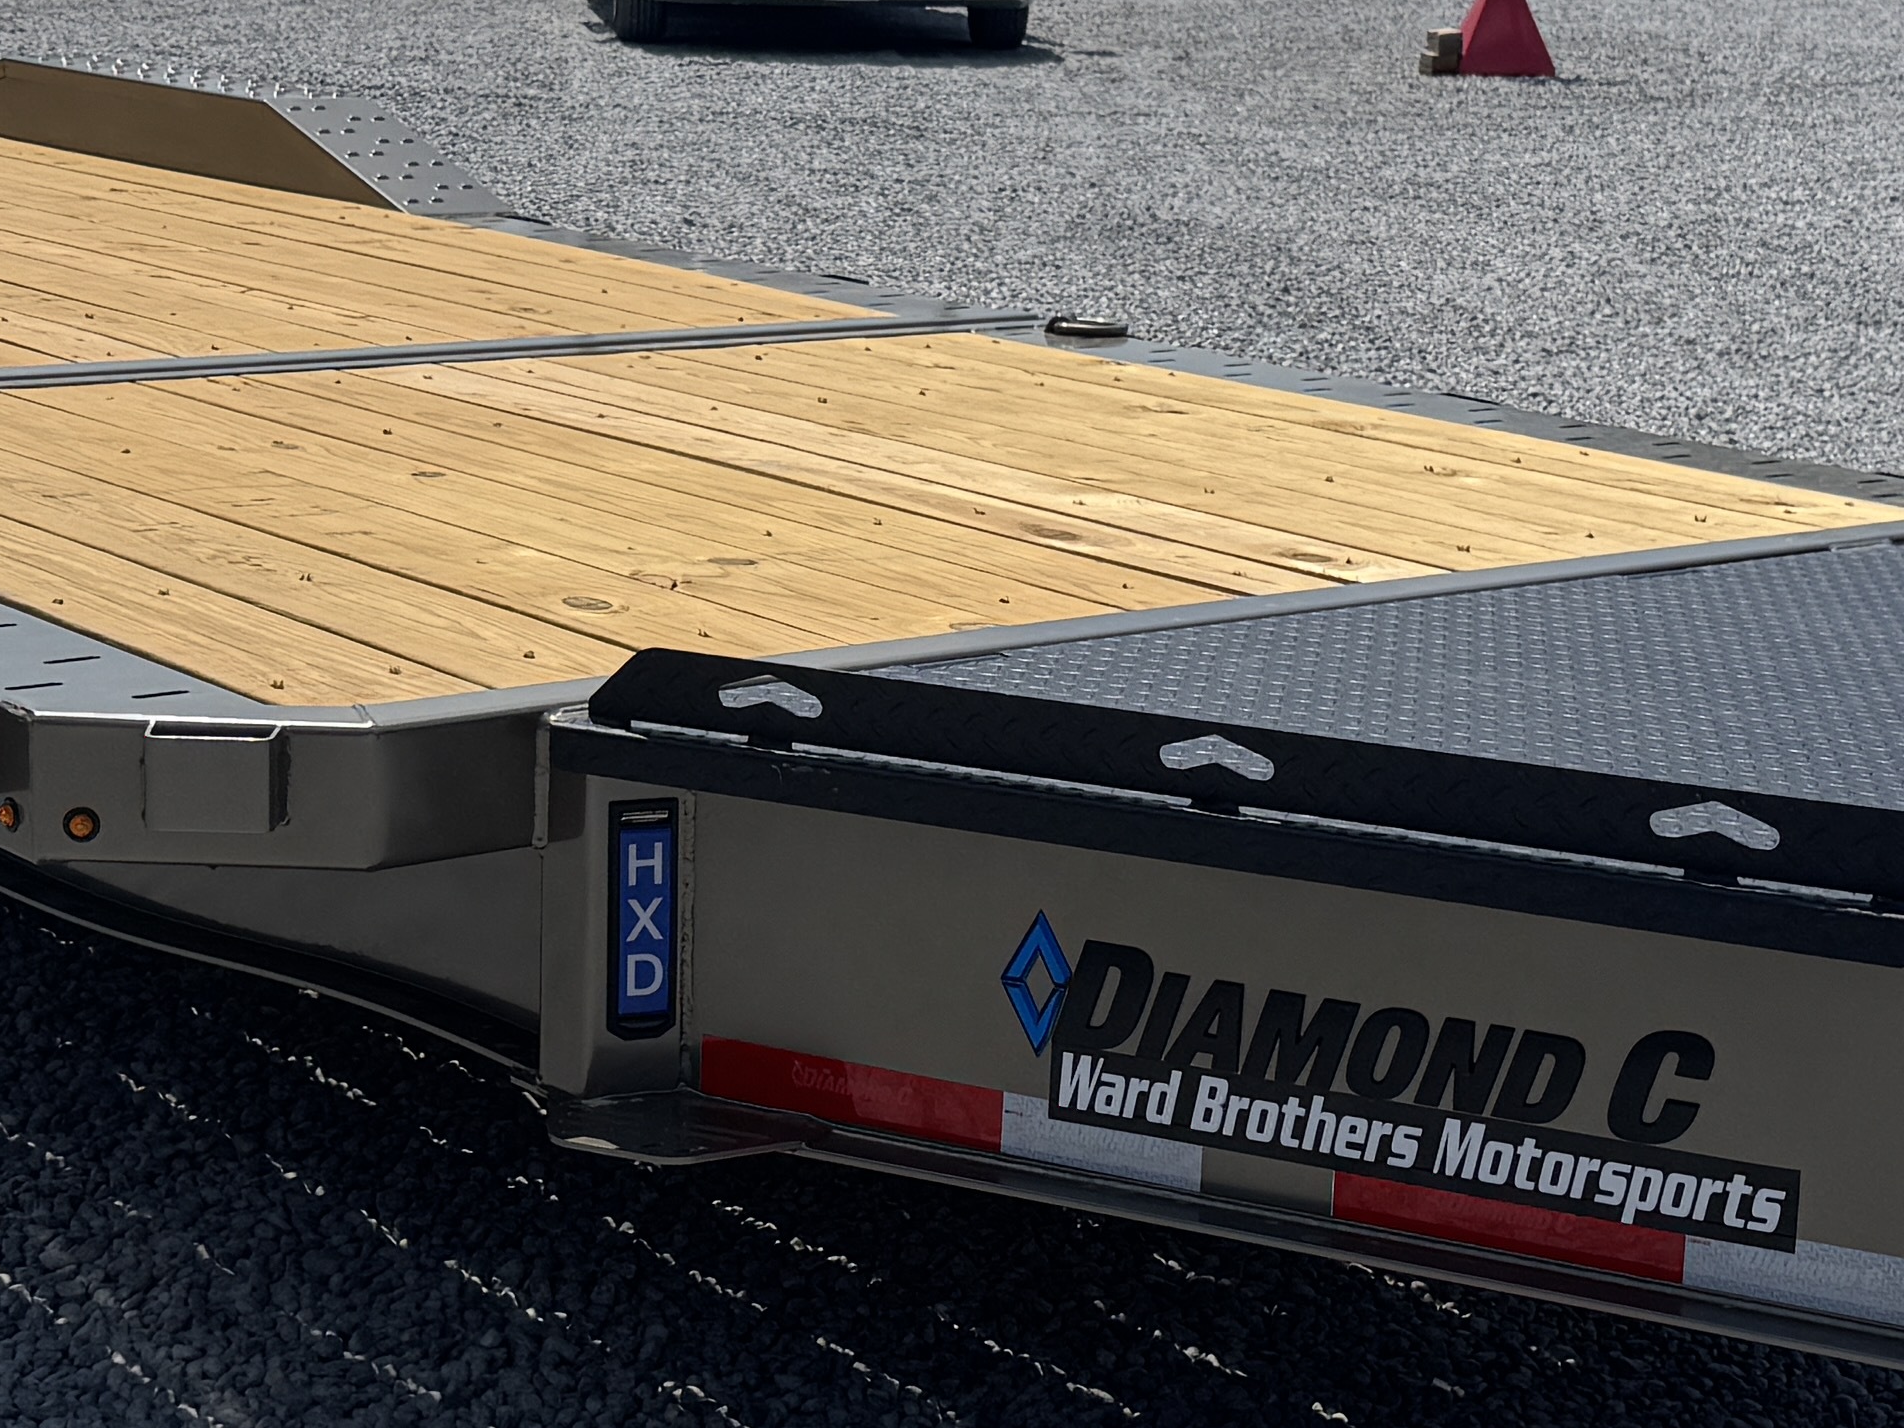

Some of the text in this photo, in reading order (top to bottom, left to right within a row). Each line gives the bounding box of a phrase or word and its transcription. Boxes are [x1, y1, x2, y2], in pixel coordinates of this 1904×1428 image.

[626, 841, 664, 997] HXD
[1052, 938, 1716, 1145] DIAMOND C
[1058, 1051, 1183, 1126] Ward
[1190, 1074, 1423, 1169] Brothers
[1432, 1118, 1787, 1234] Motorsports
